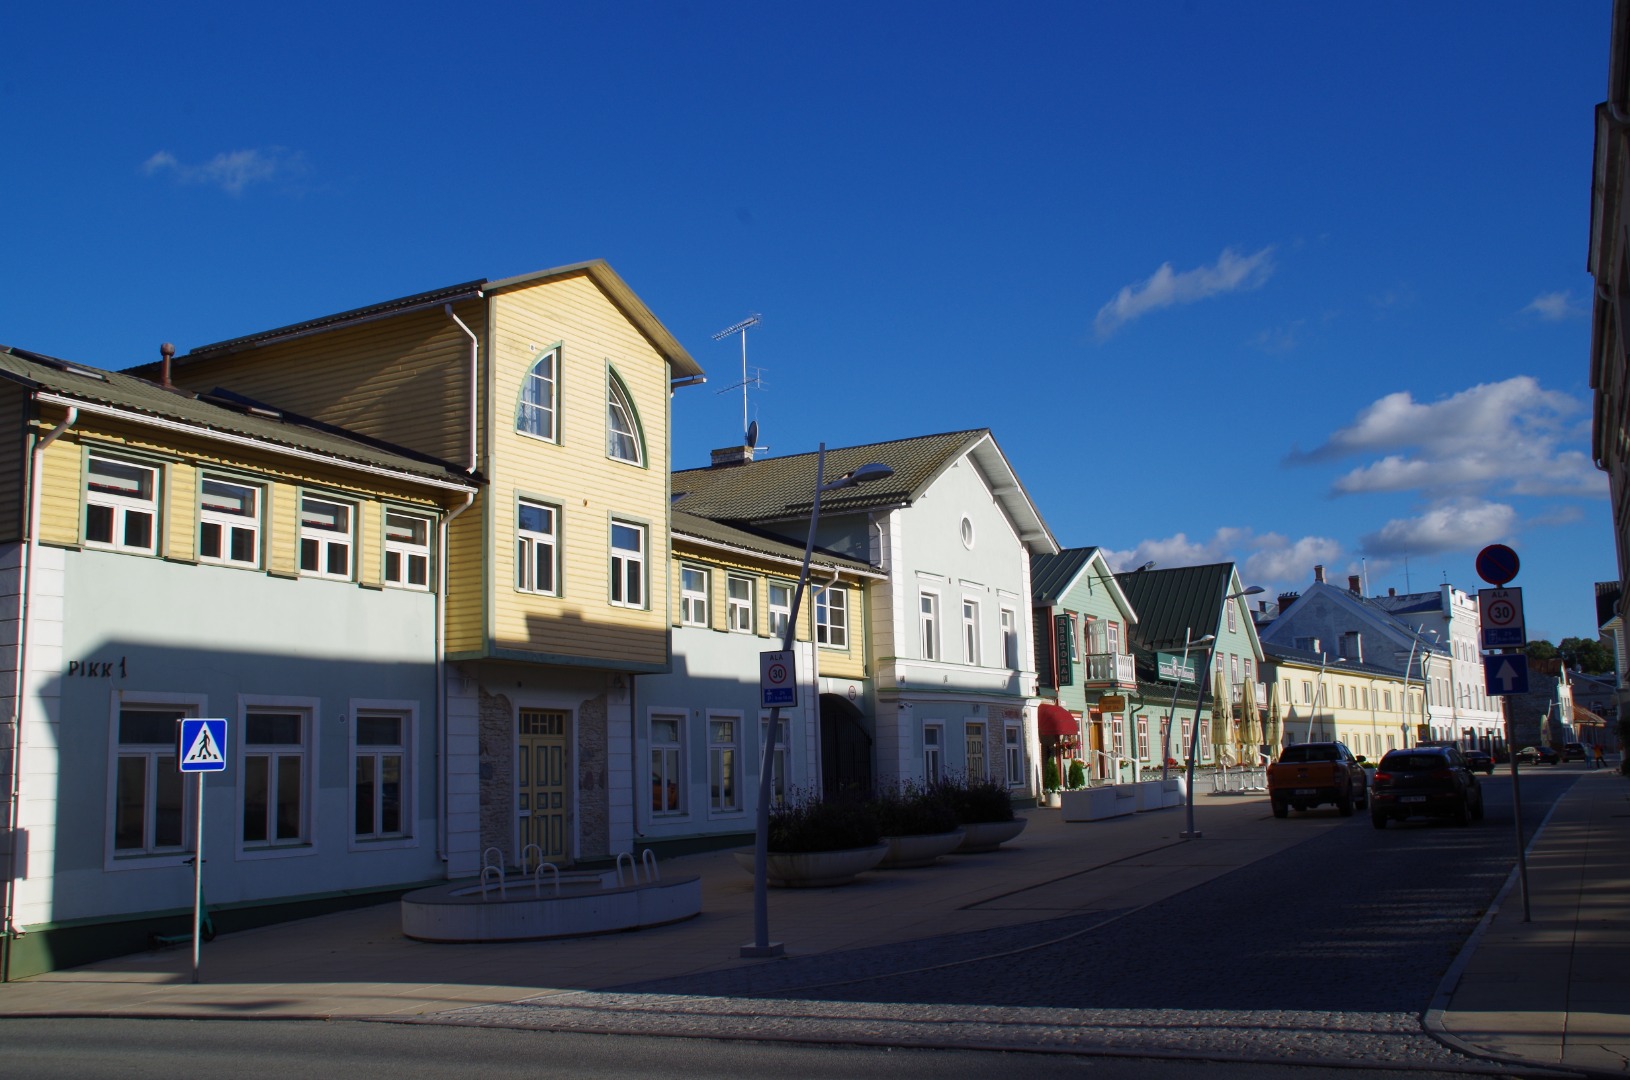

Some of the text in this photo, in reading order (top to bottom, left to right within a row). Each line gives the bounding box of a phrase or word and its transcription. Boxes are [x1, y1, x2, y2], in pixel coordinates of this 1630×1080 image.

[1491, 591, 1509, 599] ALA
[1494, 606, 1510, 619] 30
[1059, 618, 1068, 683] RESTORAN
[68, 656, 128, 679] PIKK 1
[772, 669, 783, 679] 30
